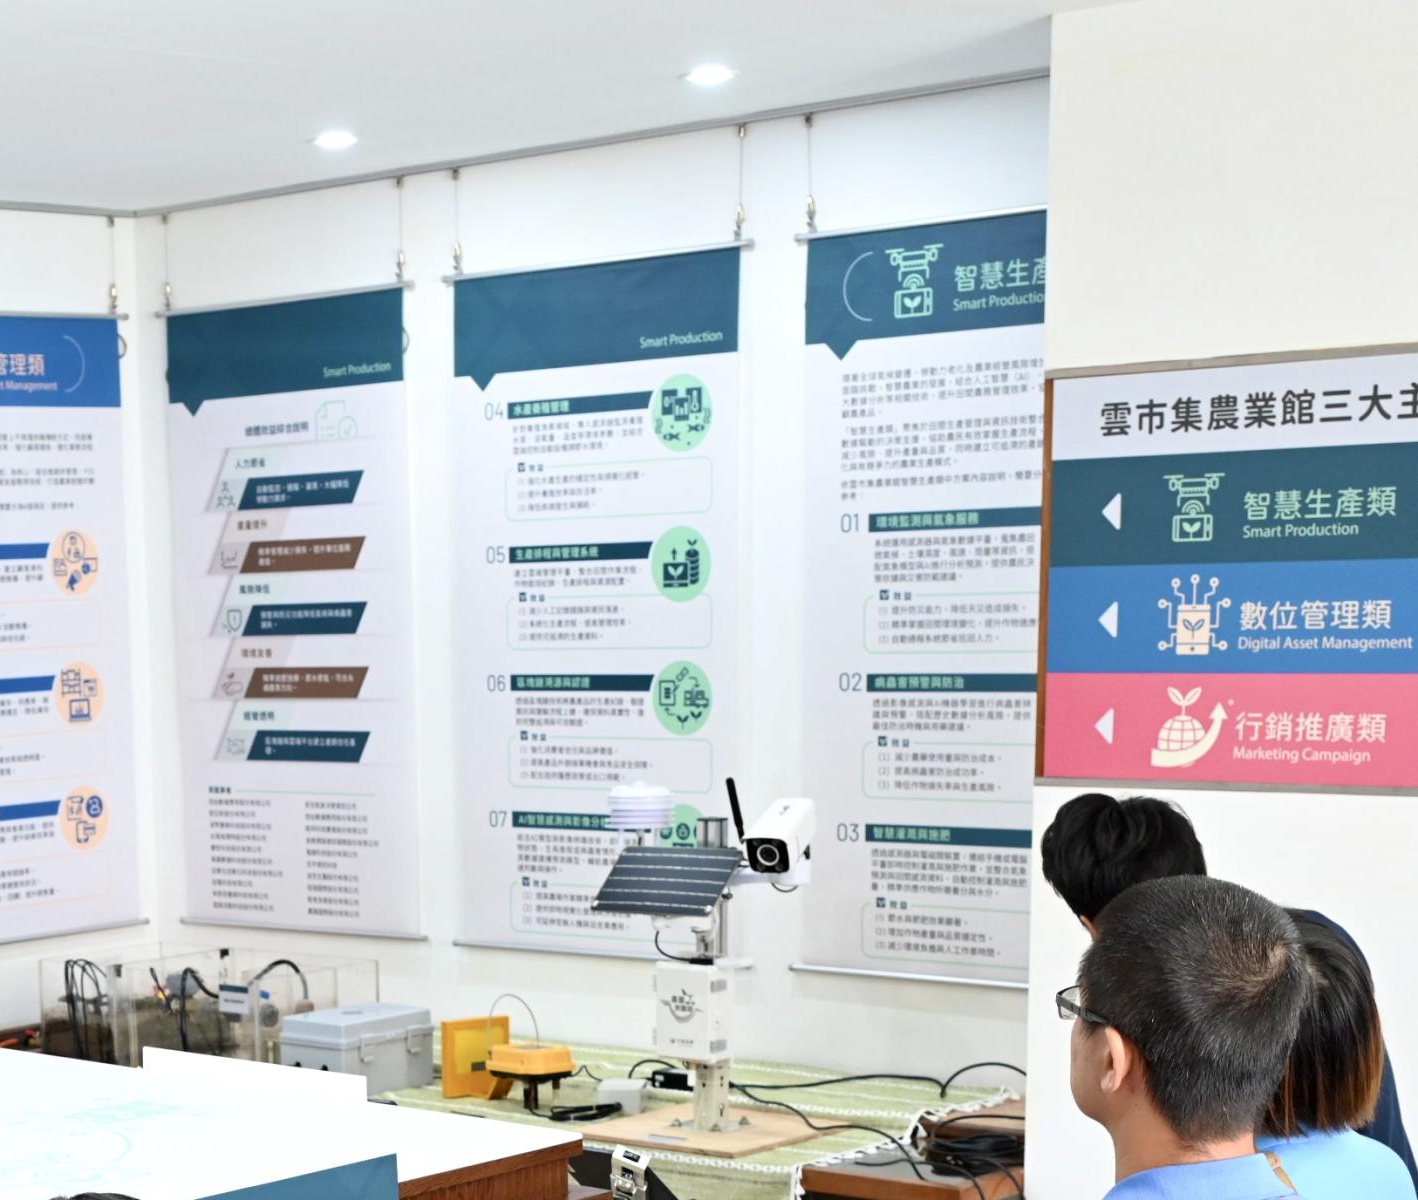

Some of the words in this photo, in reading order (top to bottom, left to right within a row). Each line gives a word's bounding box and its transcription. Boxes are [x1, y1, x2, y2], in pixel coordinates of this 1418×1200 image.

[953, 299, 987, 311] Smart
[989, 294, 1045, 307] Productio
[640, 335, 667, 349] Smart
[323, 366, 346, 378] Smart
[484, 402, 504, 420] 04
[1243, 486, 1397, 521] 智慧生產類
[841, 514, 859, 532] 01
[1243, 525, 1281, 539] Smart
[1284, 522, 1358, 537] Production
[486, 546, 505, 563] 05
[1239, 600, 1391, 631] 數位管理類
[1238, 636, 1279, 651] Digital
[1283, 636, 1318, 650] Asset
[1322, 636, 1412, 652] Management
[487, 675, 505, 691] 06
[839, 672, 861, 691] 02
[1236, 711, 1386, 743] 行銷推廣類
[1234, 746, 1299, 763] Marketing
[1302, 748, 1370, 765] Campaign
[489, 811, 507, 827] 07
[837, 824, 859, 842] 03
[874, 828, 951, 842] 智慧灌溉與施肥
